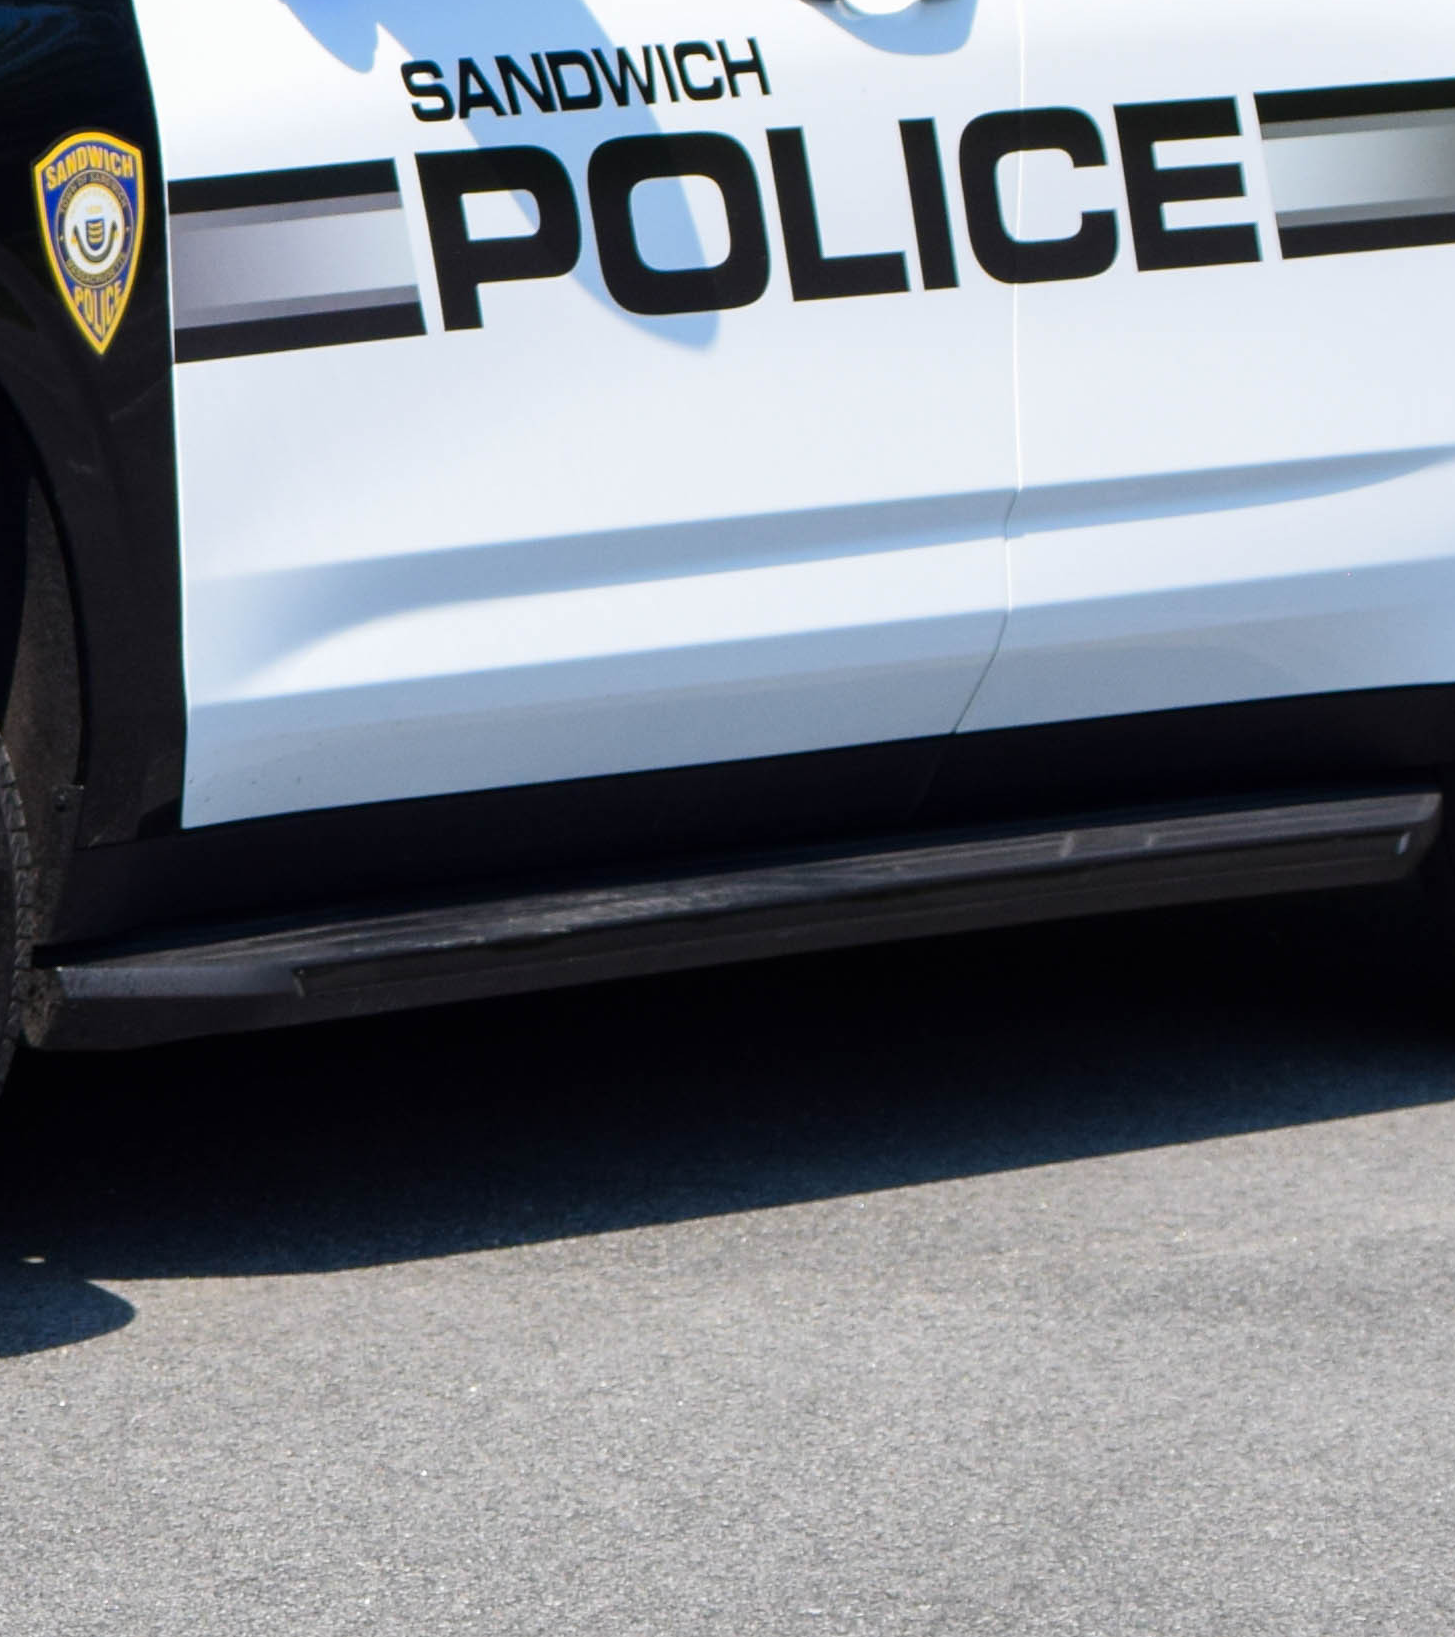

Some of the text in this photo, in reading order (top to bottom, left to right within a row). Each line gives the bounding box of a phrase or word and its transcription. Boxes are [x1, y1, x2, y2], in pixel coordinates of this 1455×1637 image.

[402, 37, 772, 123] SANDWICH
[45, 144, 135, 191] SANDWICH
[414, 95, 1264, 332] POLICE
[73, 279, 123, 337] POLICE
